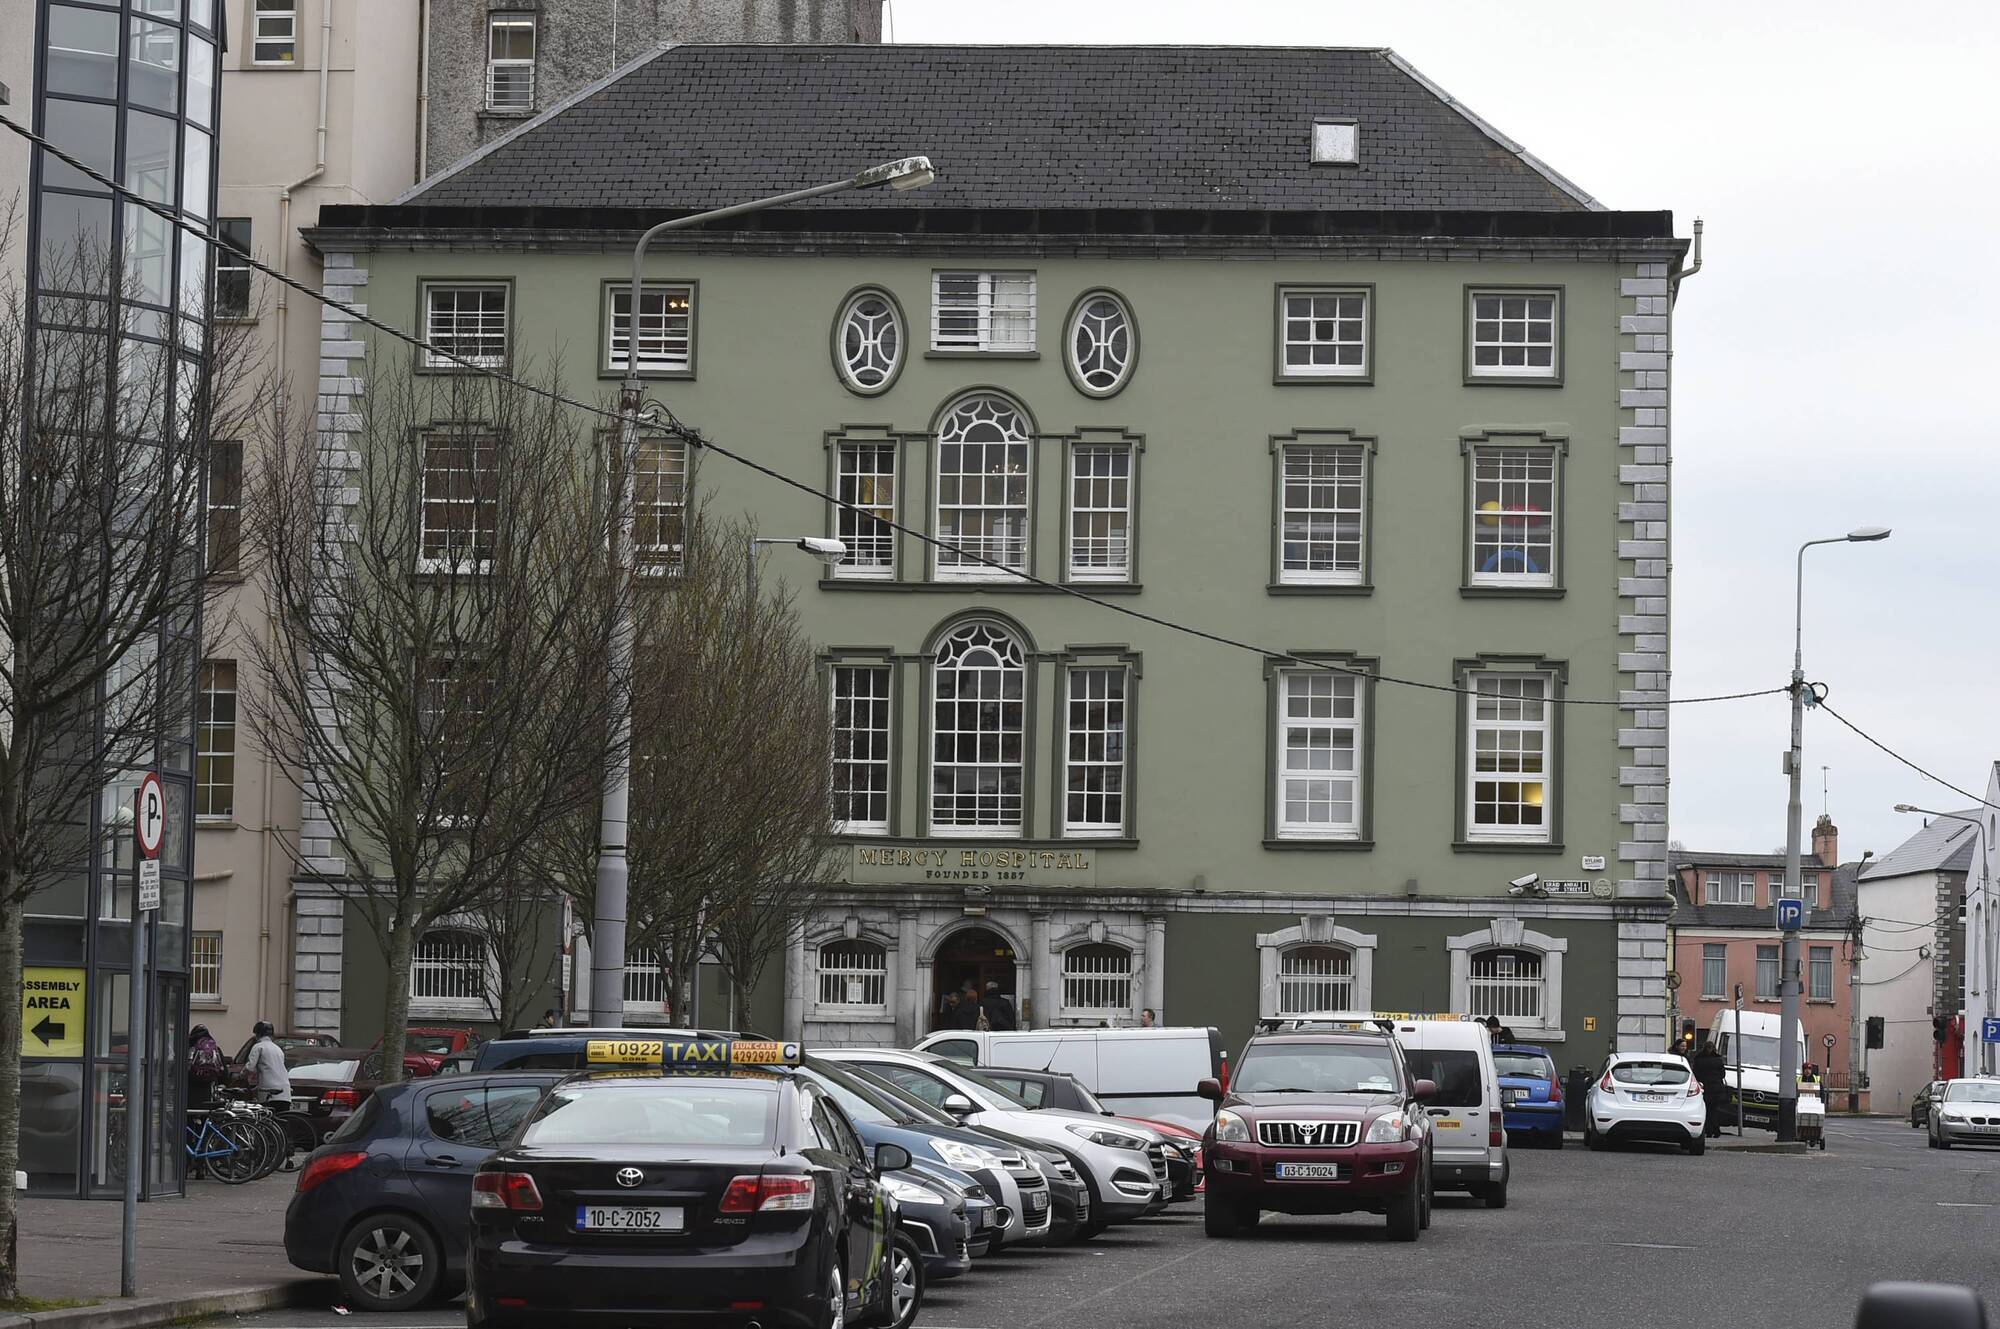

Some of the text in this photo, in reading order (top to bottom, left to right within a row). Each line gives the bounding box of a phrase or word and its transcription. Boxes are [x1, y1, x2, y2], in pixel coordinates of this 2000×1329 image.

[859, 848, 1089, 869] MERCY HOSPITAL
[926, 870, 989, 880] FOUNDED
[1786, 906, 1800, 923] P
[24, 981, 80, 991] SSEMBLY
[26, 996, 71, 1009] AREA
[1585, 1018, 1595, 1030] H
[1987, 1025, 1997, 1038] P
[609, 1043, 661, 1056] 10922
[668, 1043, 727, 1061] TAXI
[783, 1043, 797, 1060] C
[732, 1050, 777, 1063] 4292929
[591, 1210, 661, 1227] 10-C-2052
